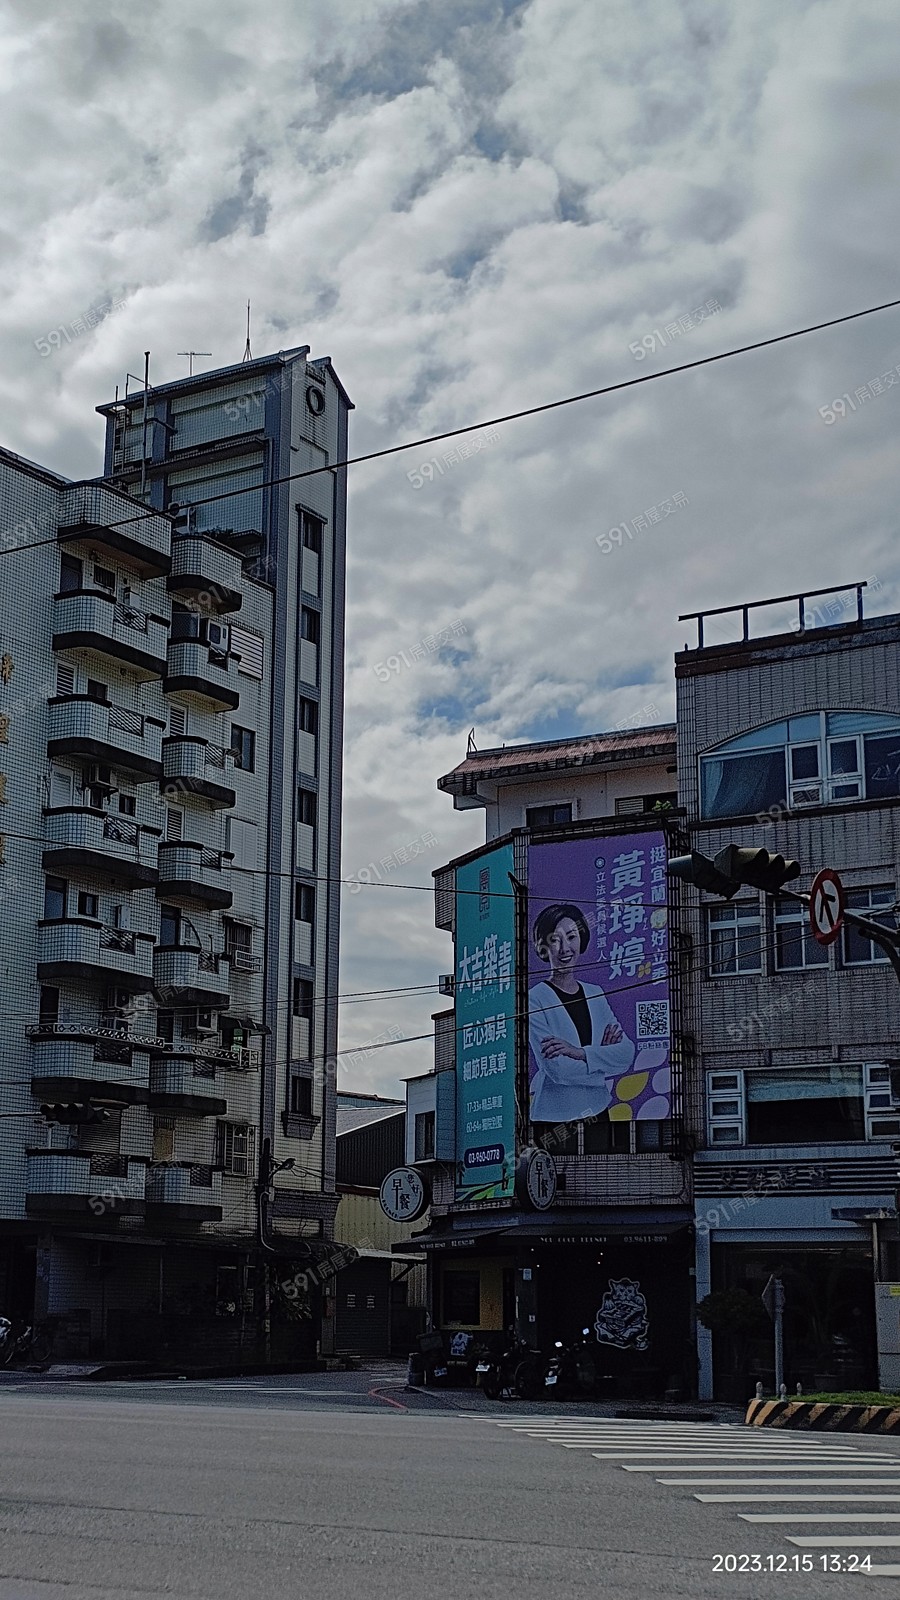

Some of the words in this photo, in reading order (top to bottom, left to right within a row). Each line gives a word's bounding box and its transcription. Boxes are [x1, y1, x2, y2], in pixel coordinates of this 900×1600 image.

[608, 849, 646, 980] 黃琤婷
[459, 934, 512, 994] 大吉築青
[462, 1013, 507, 1050] 匠心獨具
[463, 1051, 507, 1082] 細節見真章
[467, 1149, 501, 1164] 03-960-0778
[391, 1178, 410, 1211] 早餐
